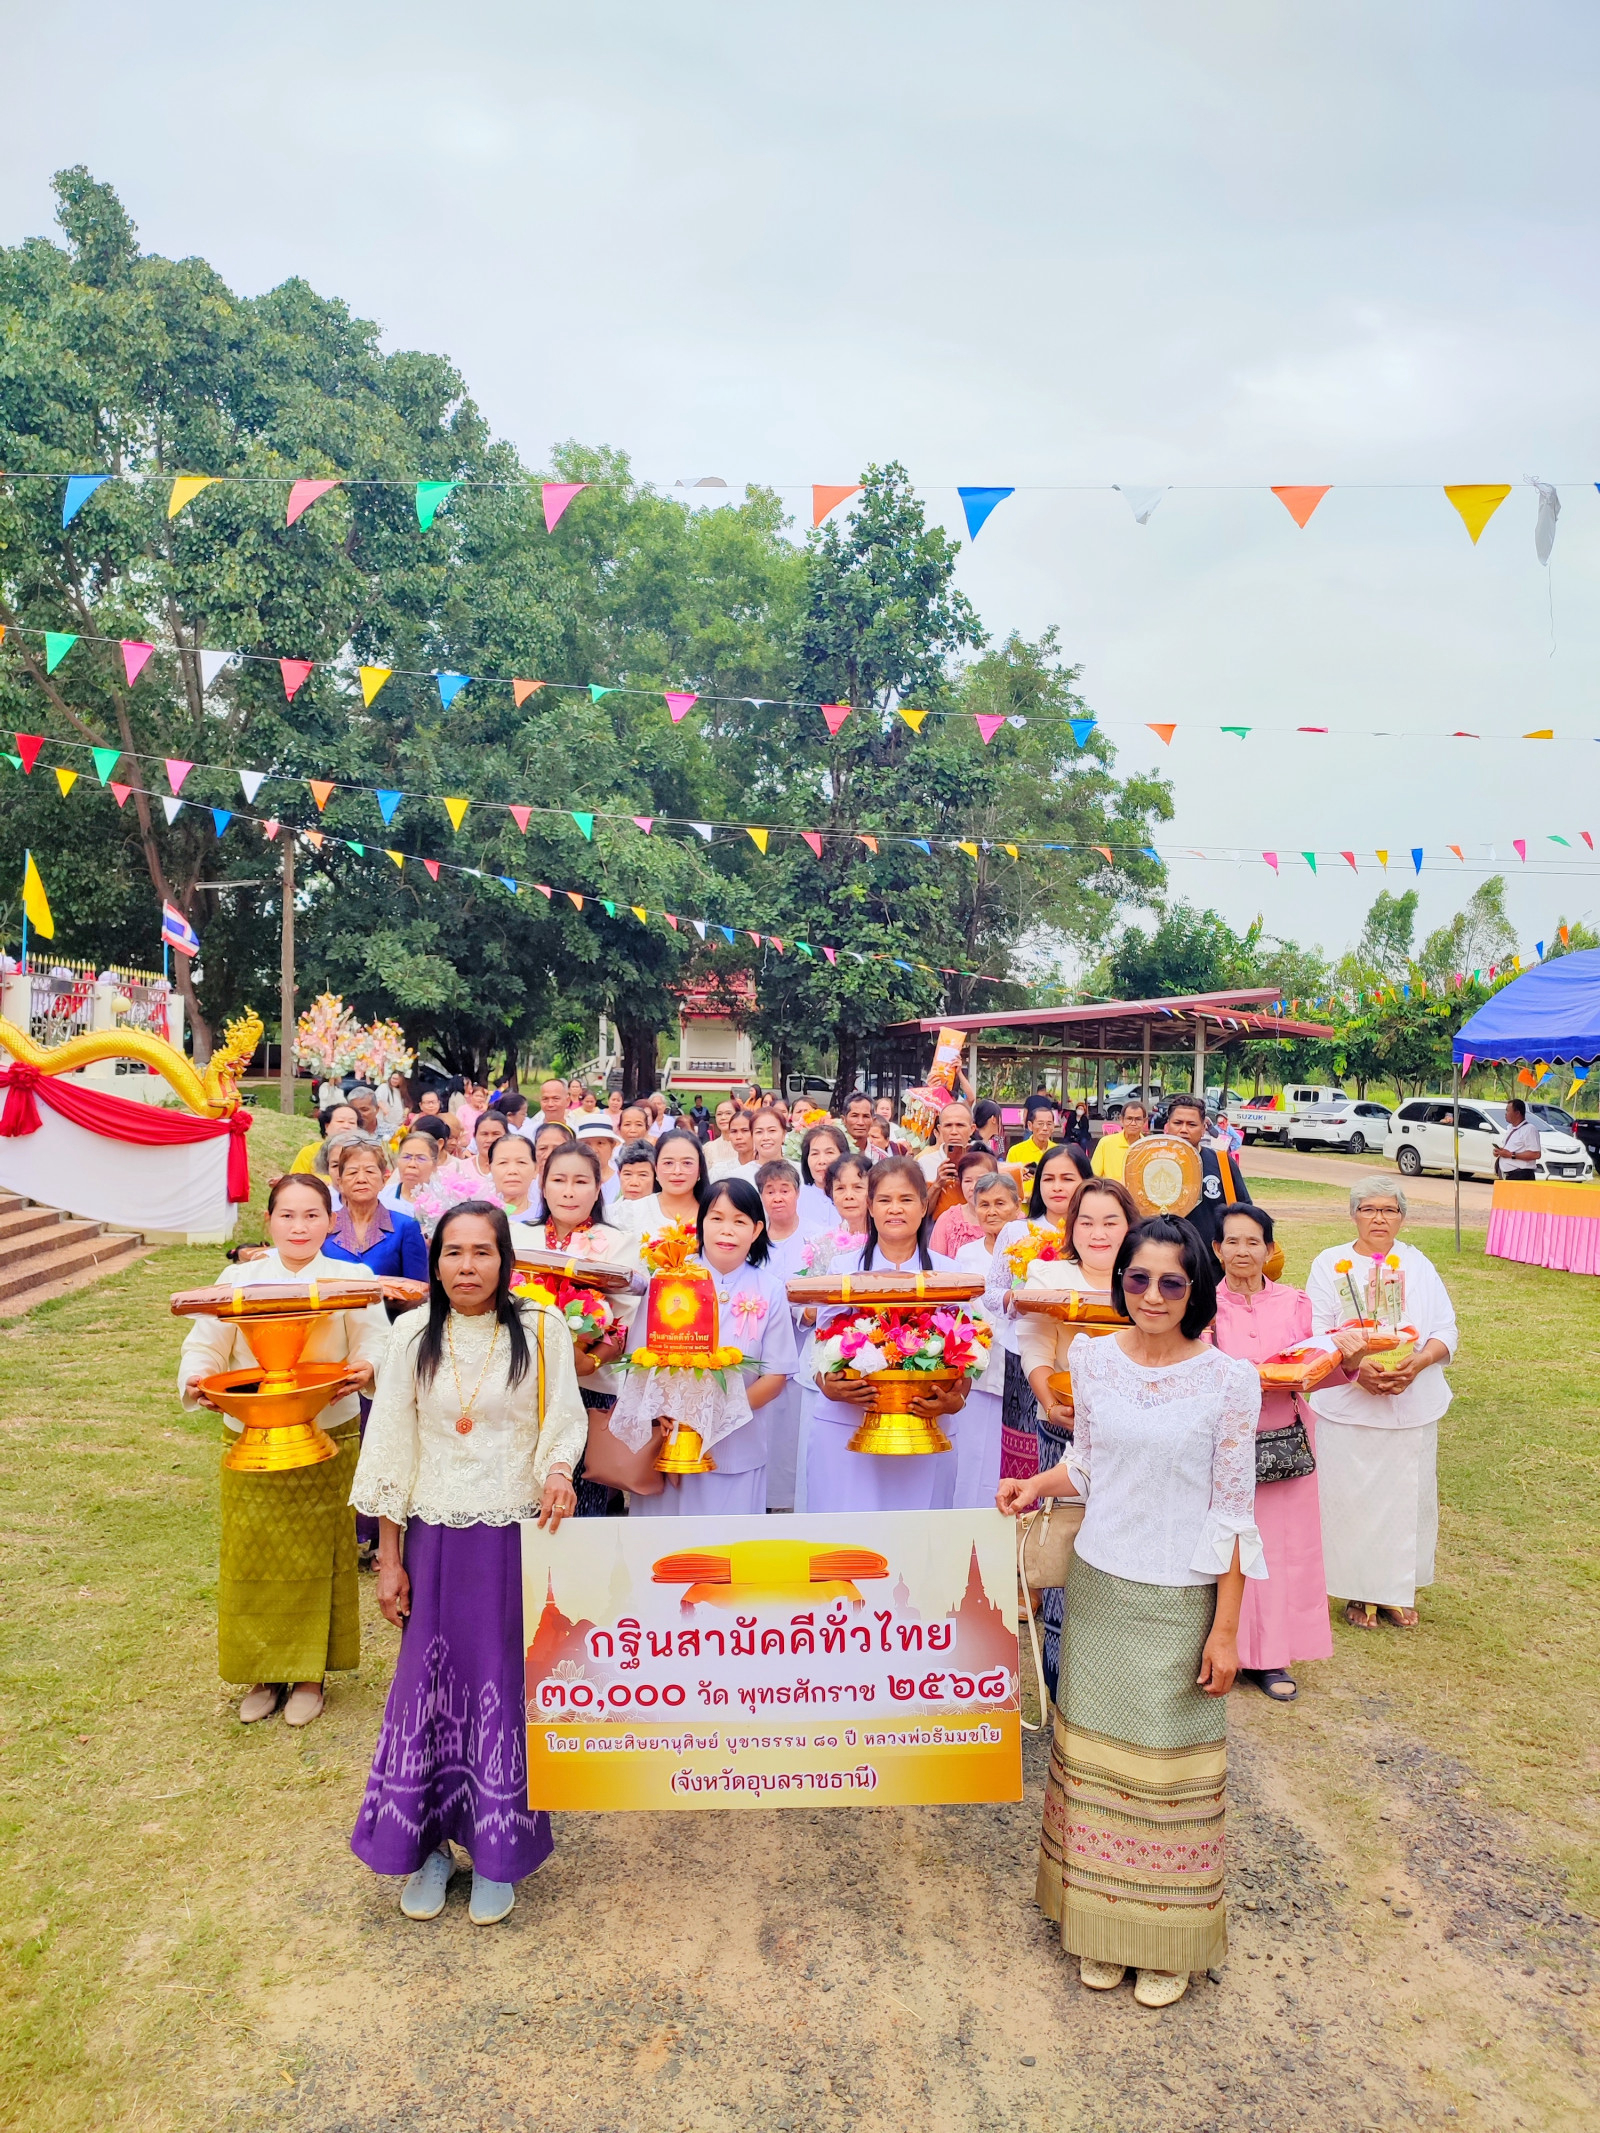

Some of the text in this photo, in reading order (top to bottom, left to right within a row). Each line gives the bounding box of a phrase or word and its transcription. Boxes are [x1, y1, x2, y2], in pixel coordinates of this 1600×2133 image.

[589, 1601, 952, 1670] กฐินสามัคคีทั่วไทย
[541, 1671, 1006, 1714] ๓๐,๐๐๐ วัด พุทธศักราช ๒๕๖๘
[547, 1725, 1002, 1755] โดย คณะศิษยานุศิษย์ บูชาธรรม ๘๑ ปี หลวงพ่อธัมมชโย
[671, 1765, 877, 1798] (จังหวัดอุบลราชธานี)
